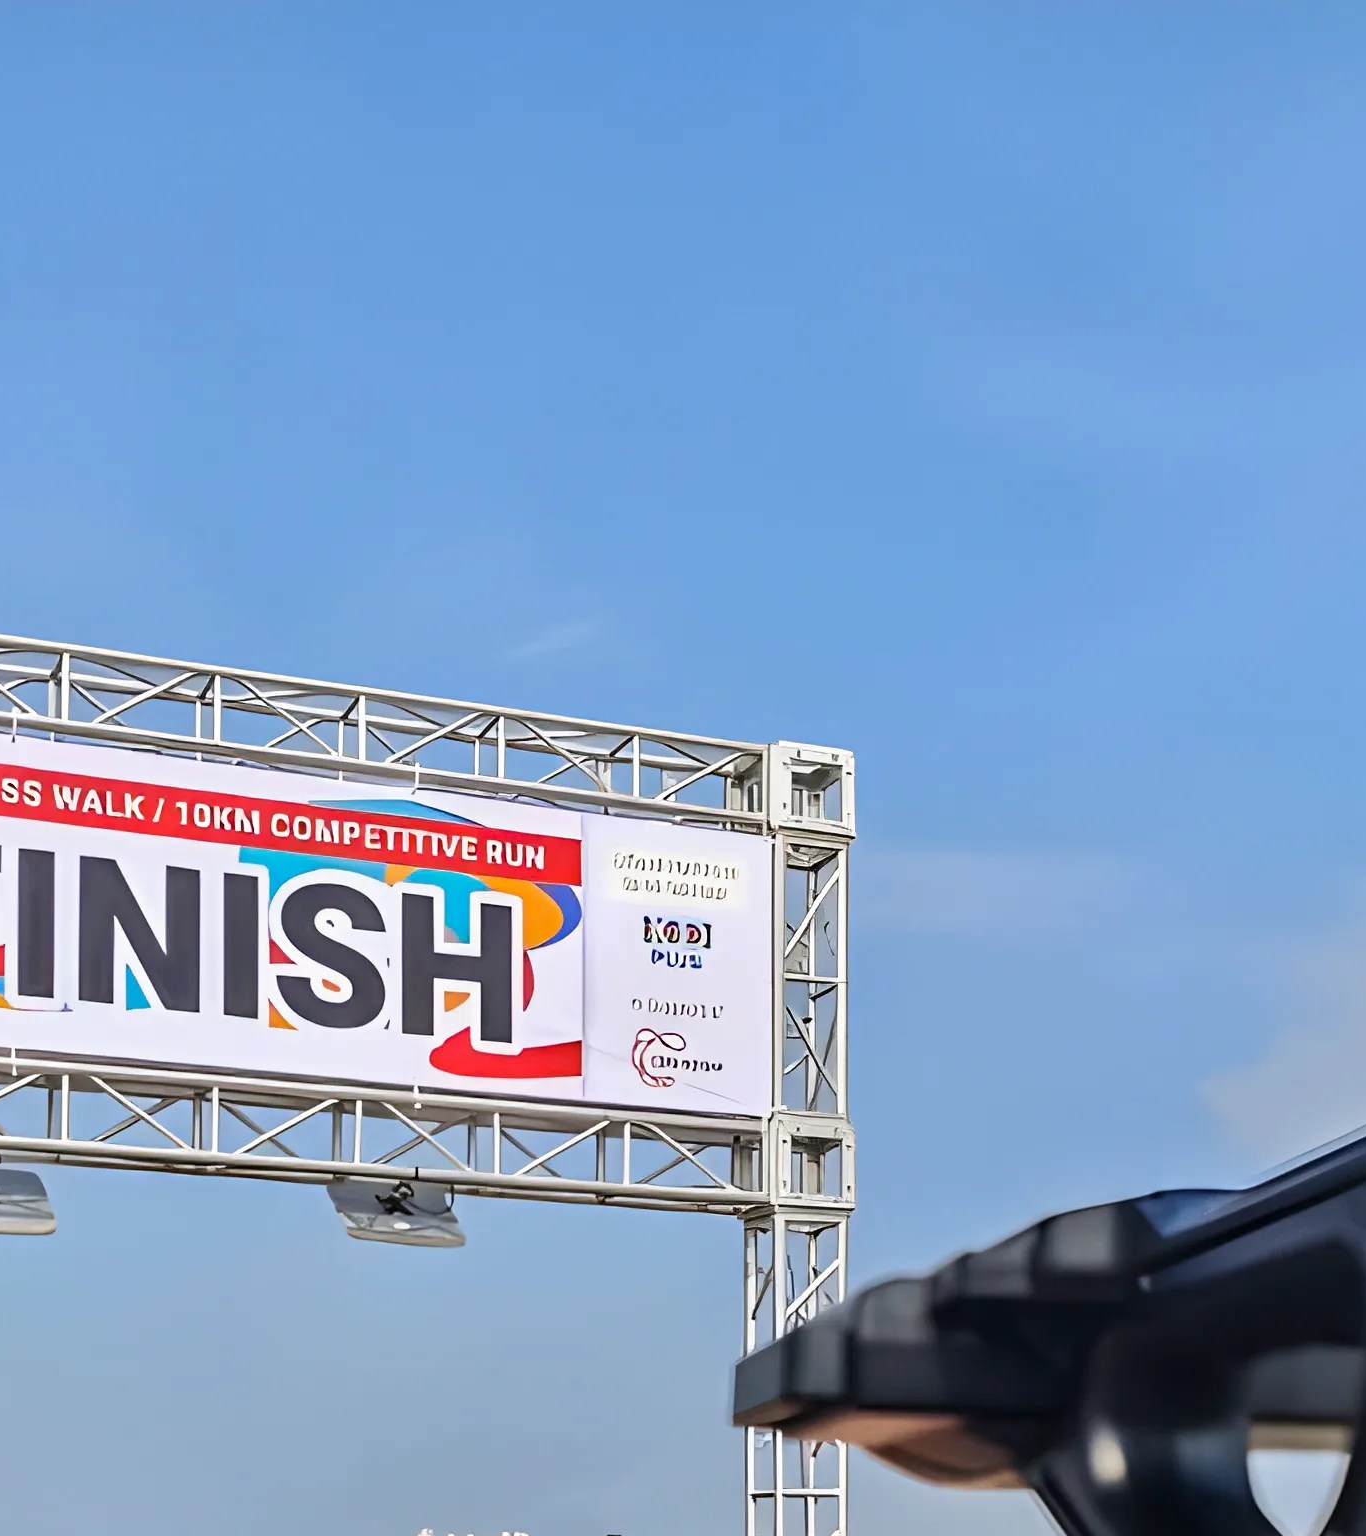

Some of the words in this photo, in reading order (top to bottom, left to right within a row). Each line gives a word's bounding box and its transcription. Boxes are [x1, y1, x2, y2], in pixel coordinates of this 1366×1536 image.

[53, 783, 145, 821] WALK
[152, 798, 165, 823] /
[175, 801, 260, 835] 10KM
[271, 813, 478, 861] COMPETITIVE
[486, 839, 546, 870] RUN
